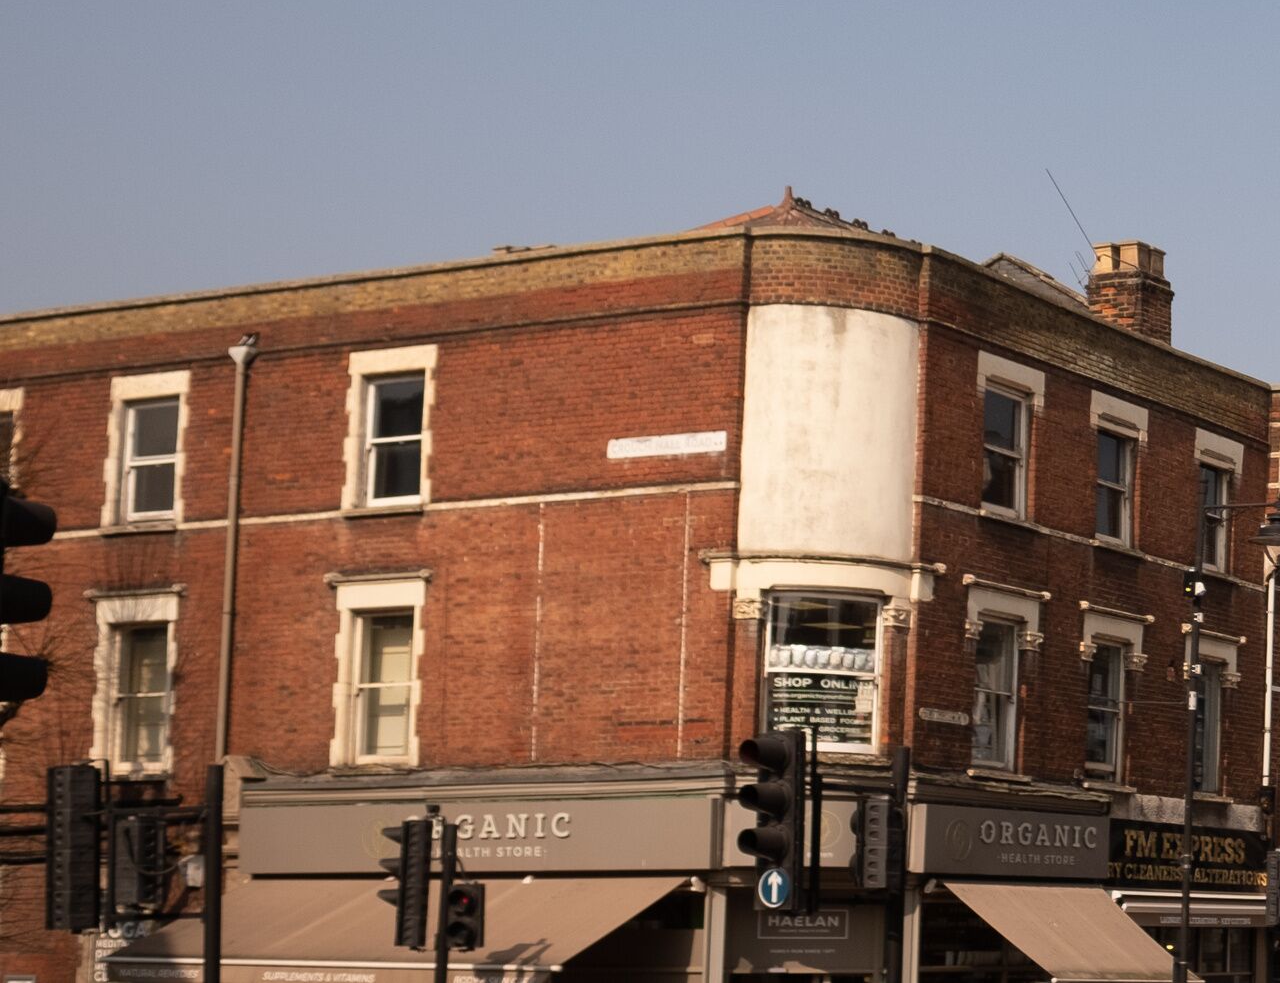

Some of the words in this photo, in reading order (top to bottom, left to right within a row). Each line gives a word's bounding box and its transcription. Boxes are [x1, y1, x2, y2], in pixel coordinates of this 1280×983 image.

[773, 677, 813, 688] SHOP
[980, 820, 1097, 849] ORGANIC
[1124, 829, 1157, 858] FM
[434, 846, 491, 858] HALTH
[496, 846, 542, 857] STORE
[1001, 853, 1041, 864] HEALTH
[1044, 855, 1076, 866] STORE
[1124, 863, 1185, 881] CLEANERS
[1193, 867, 1268, 886] ALTERATIONS
[768, 916, 839, 927] HAELAN
[262, 971, 324, 981] SUPPLEMENTS
[332, 973, 376, 983] VITAMINS
